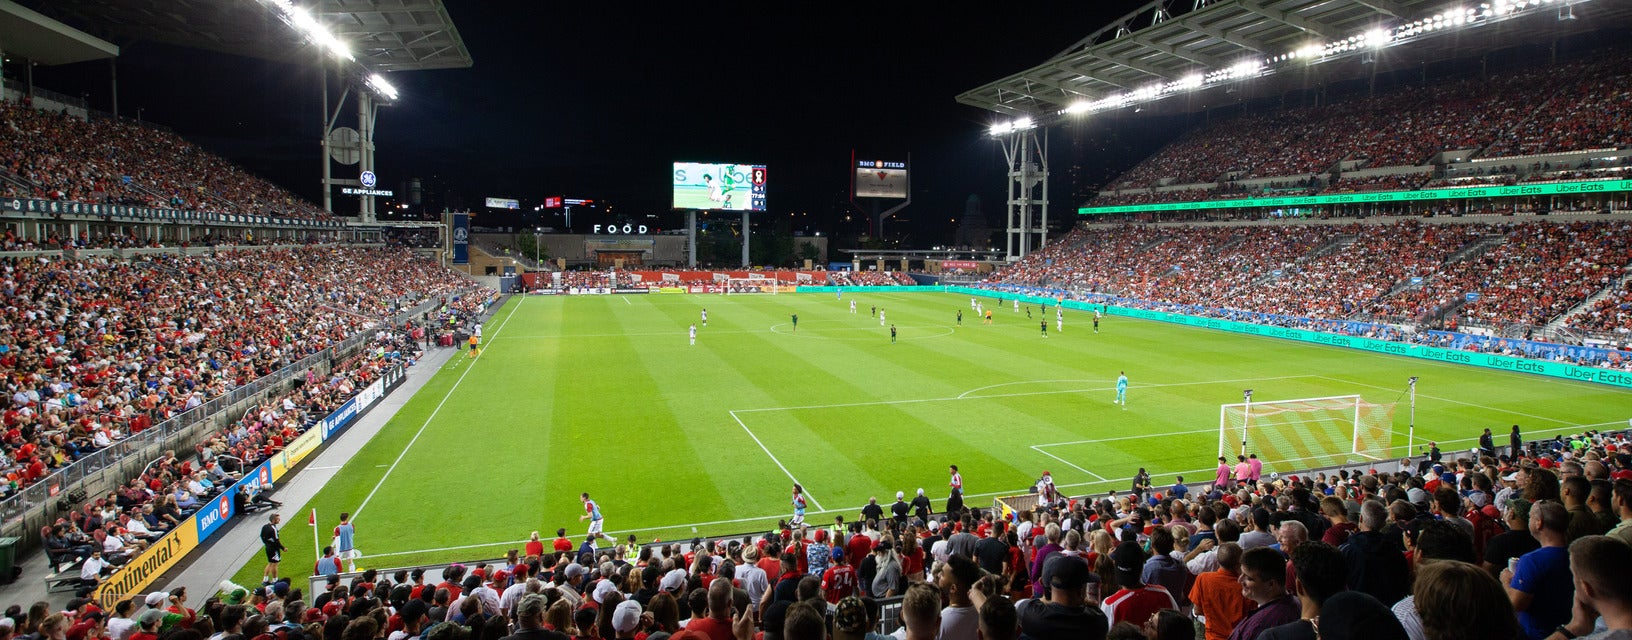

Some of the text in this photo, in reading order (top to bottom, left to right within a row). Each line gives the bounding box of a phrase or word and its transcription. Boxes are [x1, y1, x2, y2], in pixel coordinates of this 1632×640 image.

[353, 188, 393, 196] APPLIANCES
[1500, 186, 1542, 195] Uber Eats
[1556, 183, 1604, 193] Uber Eats
[593, 224, 648, 234] FOOD
[1229, 322, 1260, 333] Uber Eats
[1269, 327, 1302, 339] Uber Eats
[1312, 333, 1351, 346] Uber Eats
[1363, 340, 1407, 354] Uber Eats
[1421, 348, 1471, 363] Uber Eats
[1487, 356, 1545, 373] Uber Eats
[1564, 366, 1632, 385] Uber Eats
[328, 402, 356, 431] GE APPLIANCES
[201, 508, 219, 531] BMO
[100, 538, 173, 610] Continental
[834, 572, 852, 589] 24
